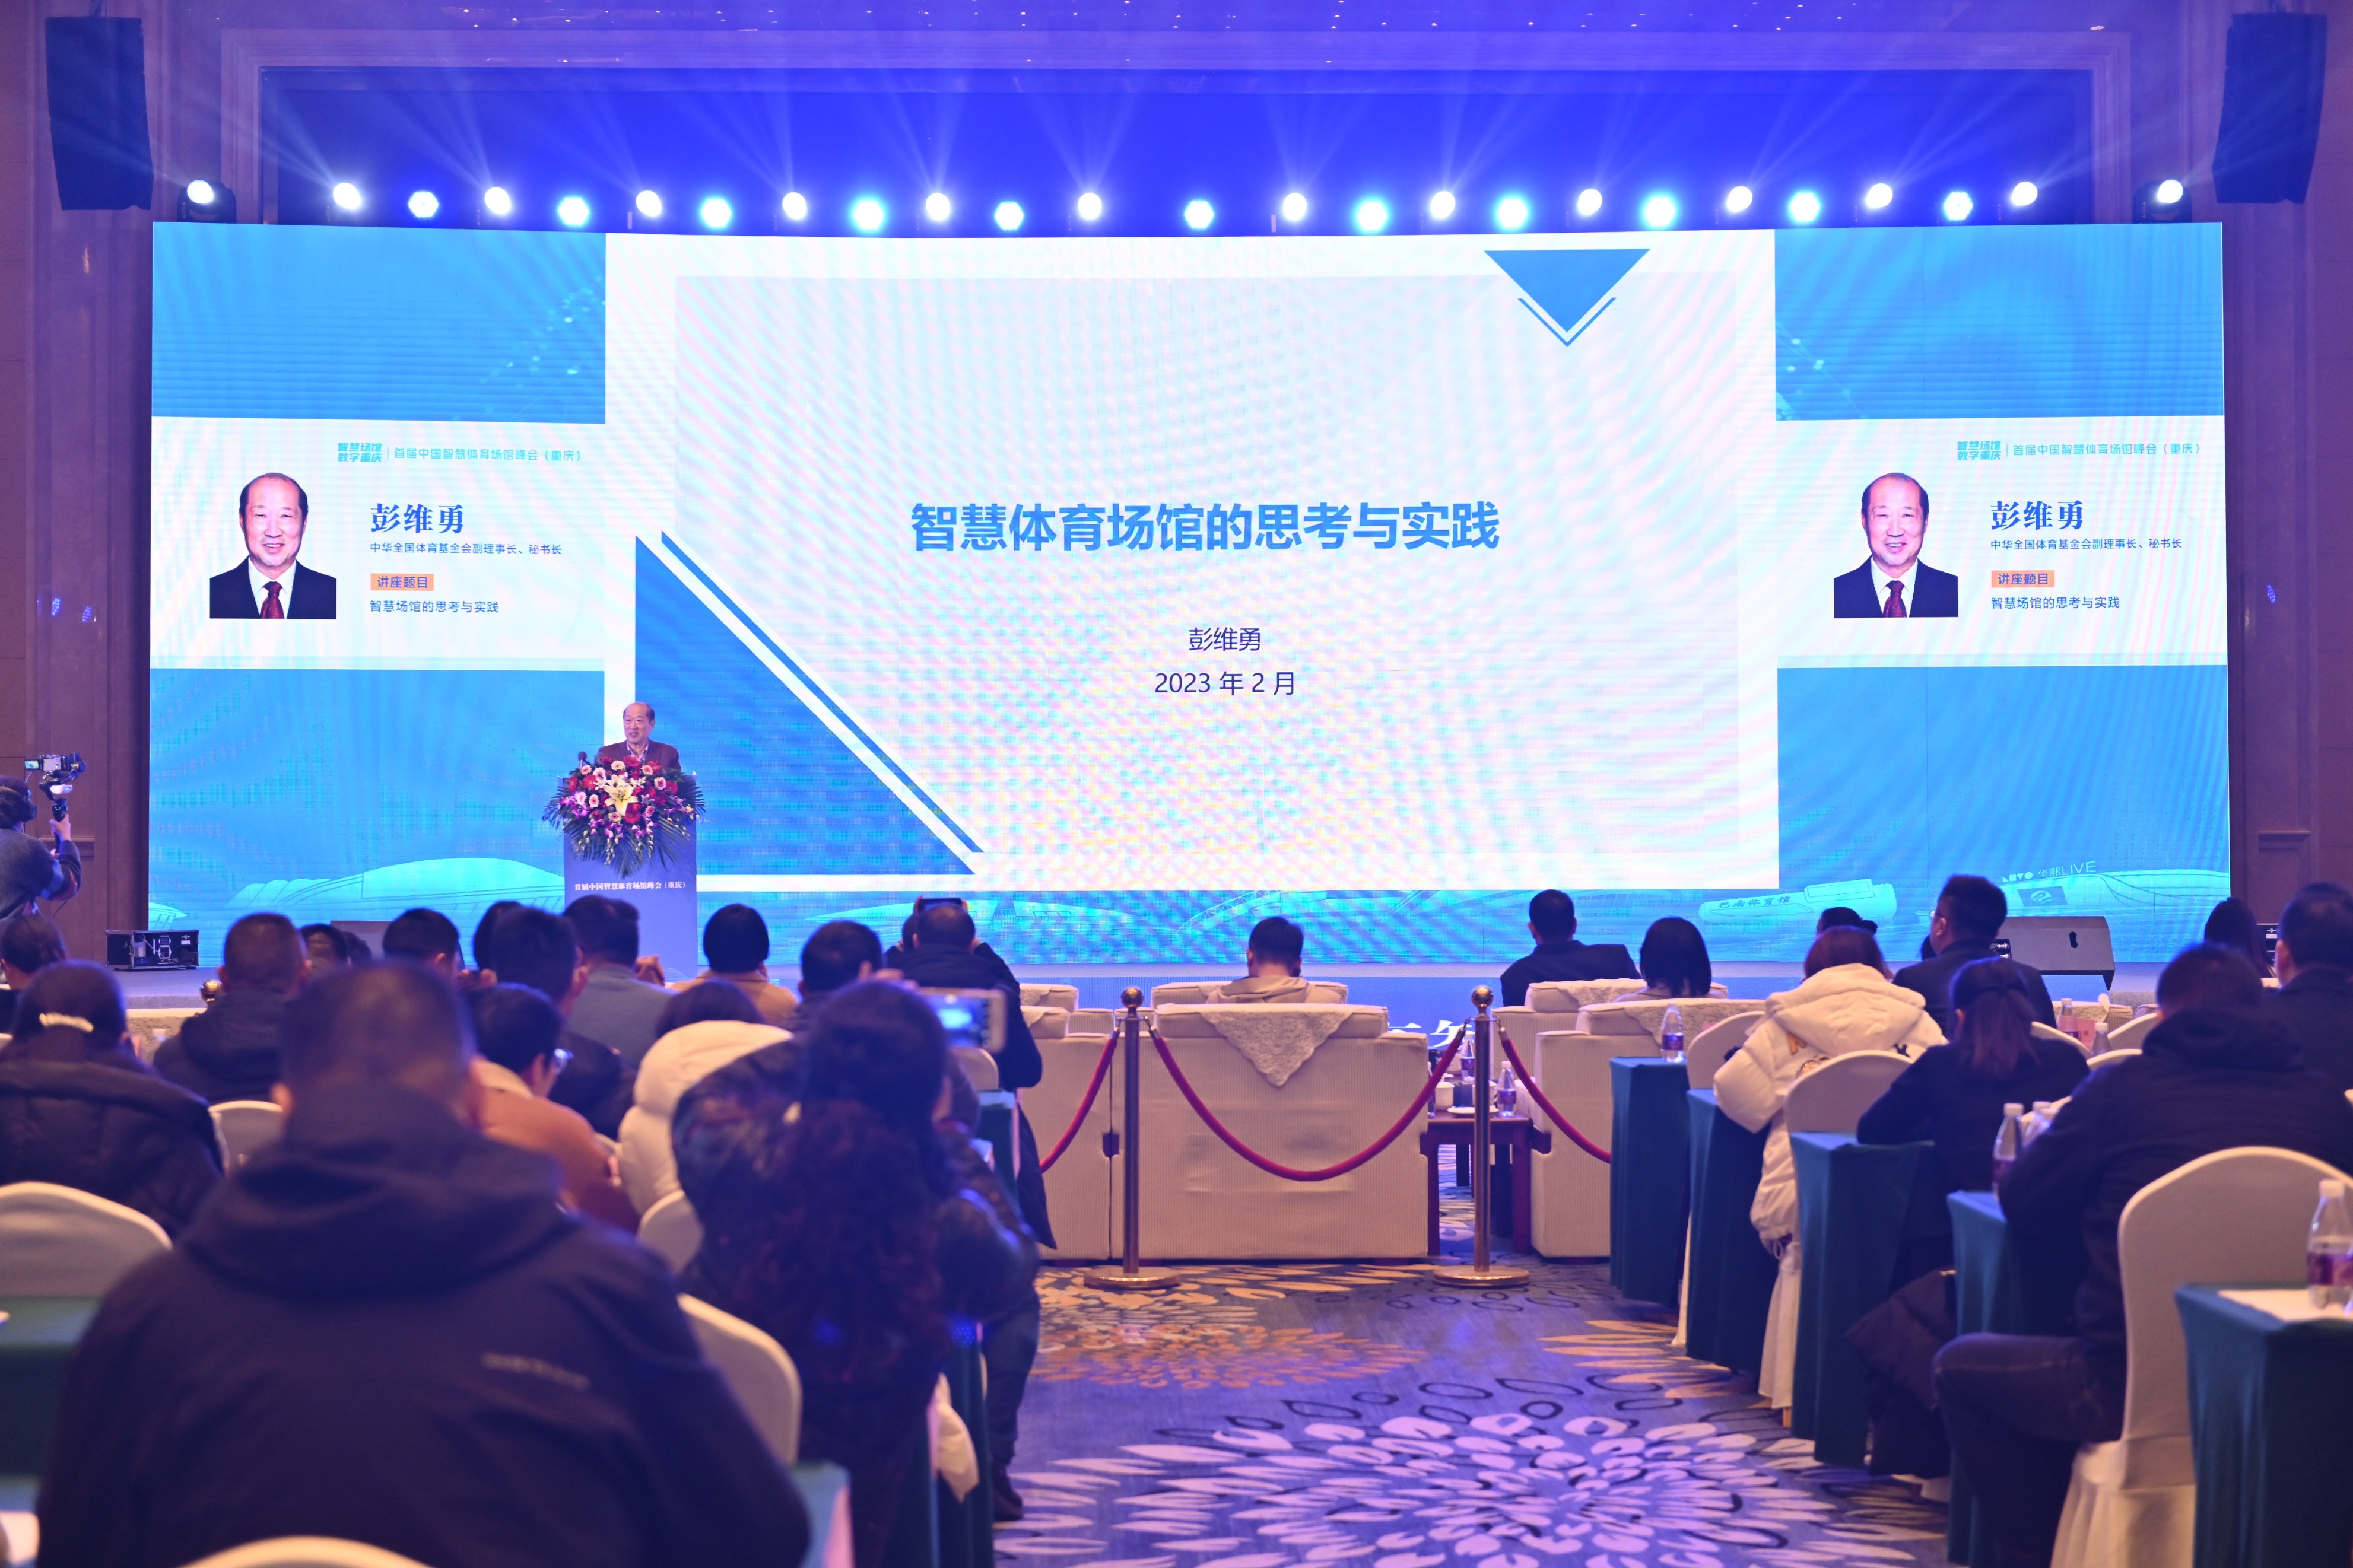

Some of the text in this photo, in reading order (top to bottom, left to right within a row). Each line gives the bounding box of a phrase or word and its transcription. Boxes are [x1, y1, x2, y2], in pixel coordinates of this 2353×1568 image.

[338, 443, 382, 452] 智慧场馆
[1957, 441, 2001, 450] 智慧场馆
[371, 503, 463, 534] 彭维勇
[1991, 500, 2083, 530] 彭维勇
[911, 501, 1500, 552] 智慧体育场馆的思考与实践
[370, 542, 563, 555] 中华全国体育基金会副理事长、秘书长
[1990, 538, 2183, 550] 中华全国体育基金会副理事长、秘书长
[377, 575, 428, 589] 讲座题目
[1998, 573, 2049, 586] 讲座题目
[370, 600, 499, 613] 智慧场馆的思考与实践
[1991, 596, 2120, 610] 智慧场馆的思考与实践
[1189, 626, 1262, 652] 彭维勇
[1154, 672, 1211, 693] 2023
